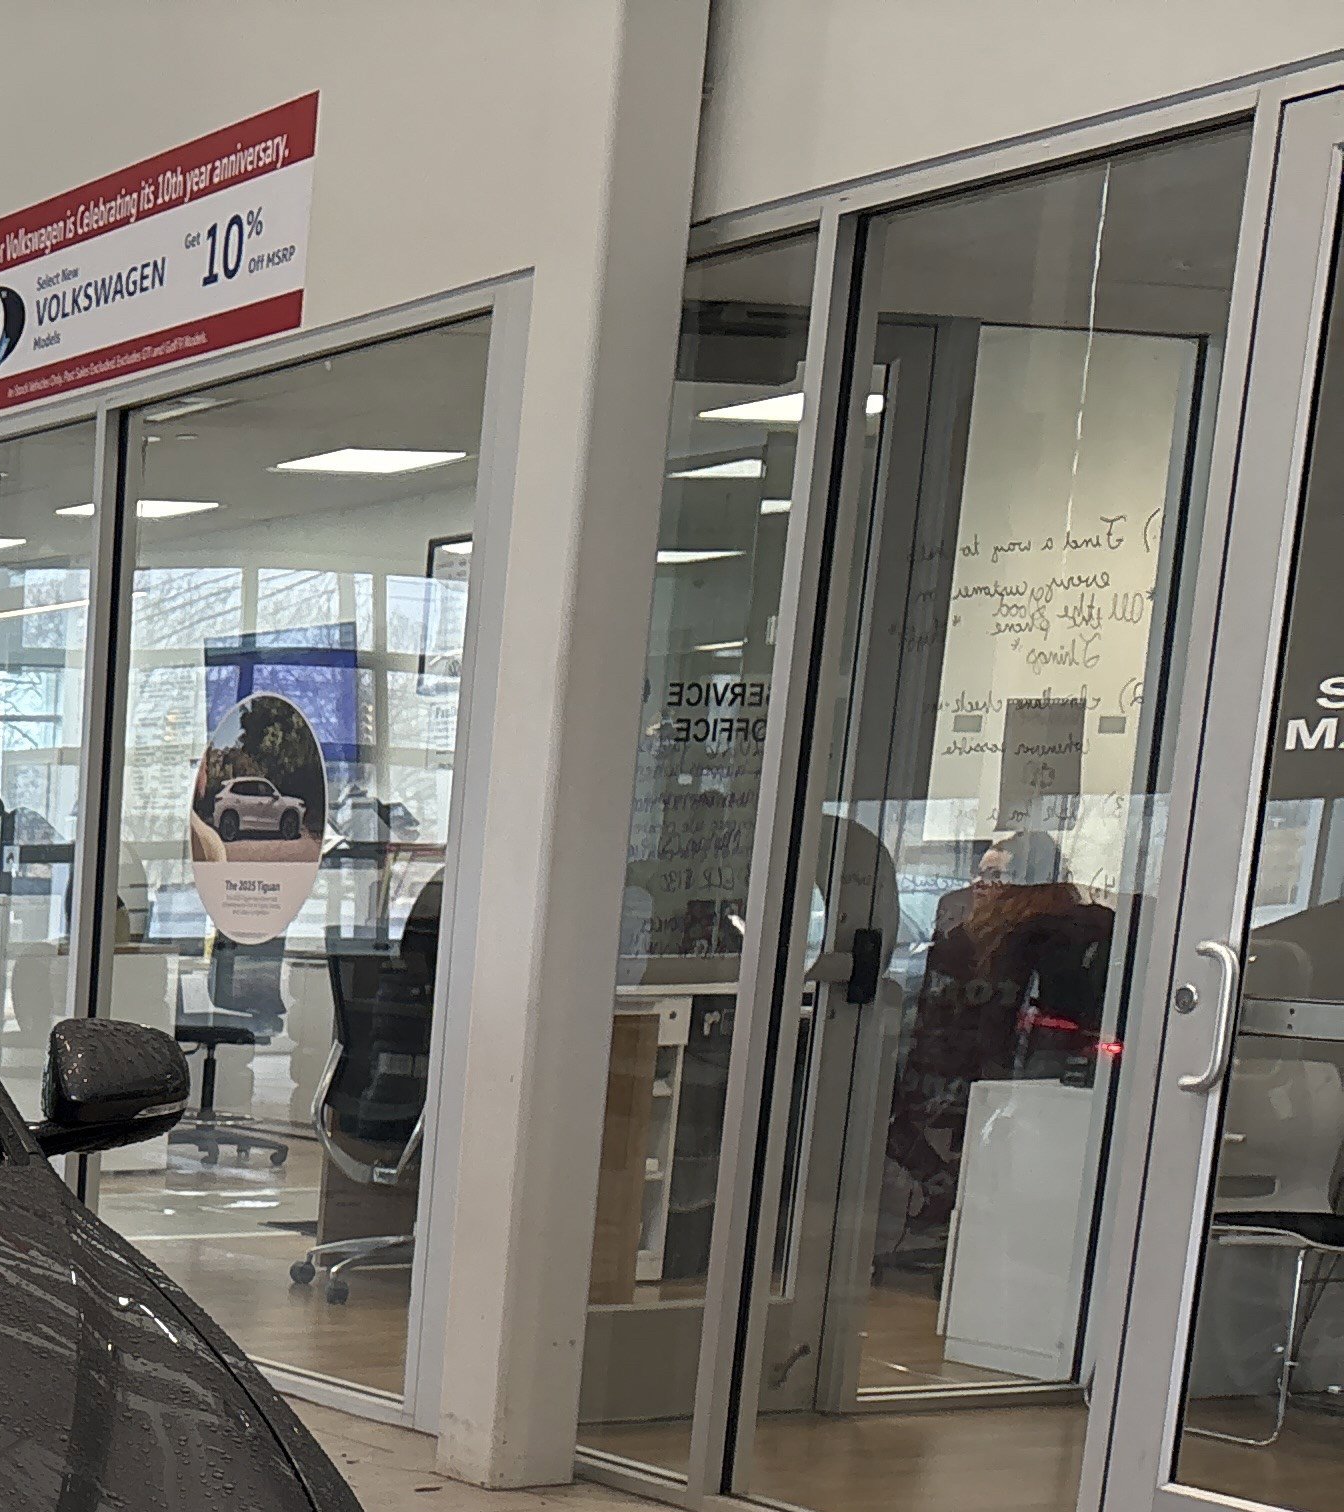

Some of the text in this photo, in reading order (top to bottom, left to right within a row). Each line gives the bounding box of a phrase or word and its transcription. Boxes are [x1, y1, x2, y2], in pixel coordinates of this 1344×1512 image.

[6, 220, 65, 262] Volkswagen
[66, 209, 75, 239] is
[76, 188, 139, 234] Celebrating
[156, 166, 184, 205] 10th
[184, 162, 212, 202] year
[213, 134, 290, 184] anniversary.
[184, 231, 201, 249] Get
[247, 245, 296, 274] Off MSRP
[35, 256, 167, 327] VOLKSWAGEN
[36, 272, 60, 291] Select
[32, 330, 61, 351] Models
